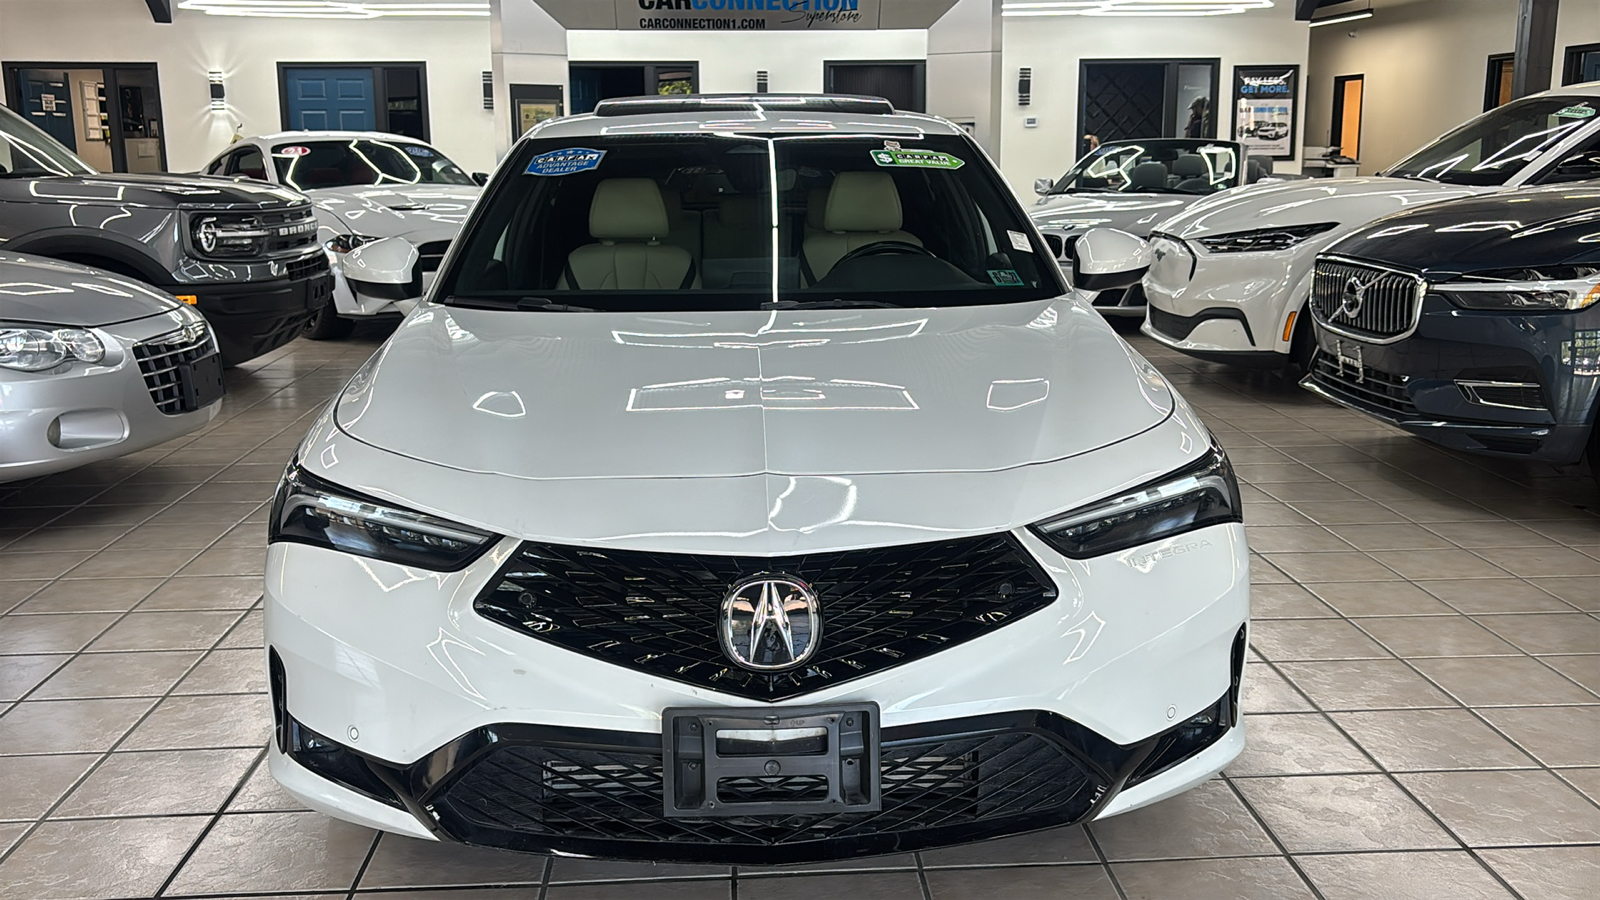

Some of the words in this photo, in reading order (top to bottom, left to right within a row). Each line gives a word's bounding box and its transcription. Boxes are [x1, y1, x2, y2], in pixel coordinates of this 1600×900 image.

[781, 1, 862, 28] Superstore
[639, 18, 766, 29] CARCONNECTION1.COM
[536, 154, 599, 163] CARFAX
[895, 154, 949, 162] CARFAX
[536, 160, 589, 169] ADVANTAGE
[541, 166, 578, 174] DEALER
[1124, 540, 1213, 568] INTEGRA
